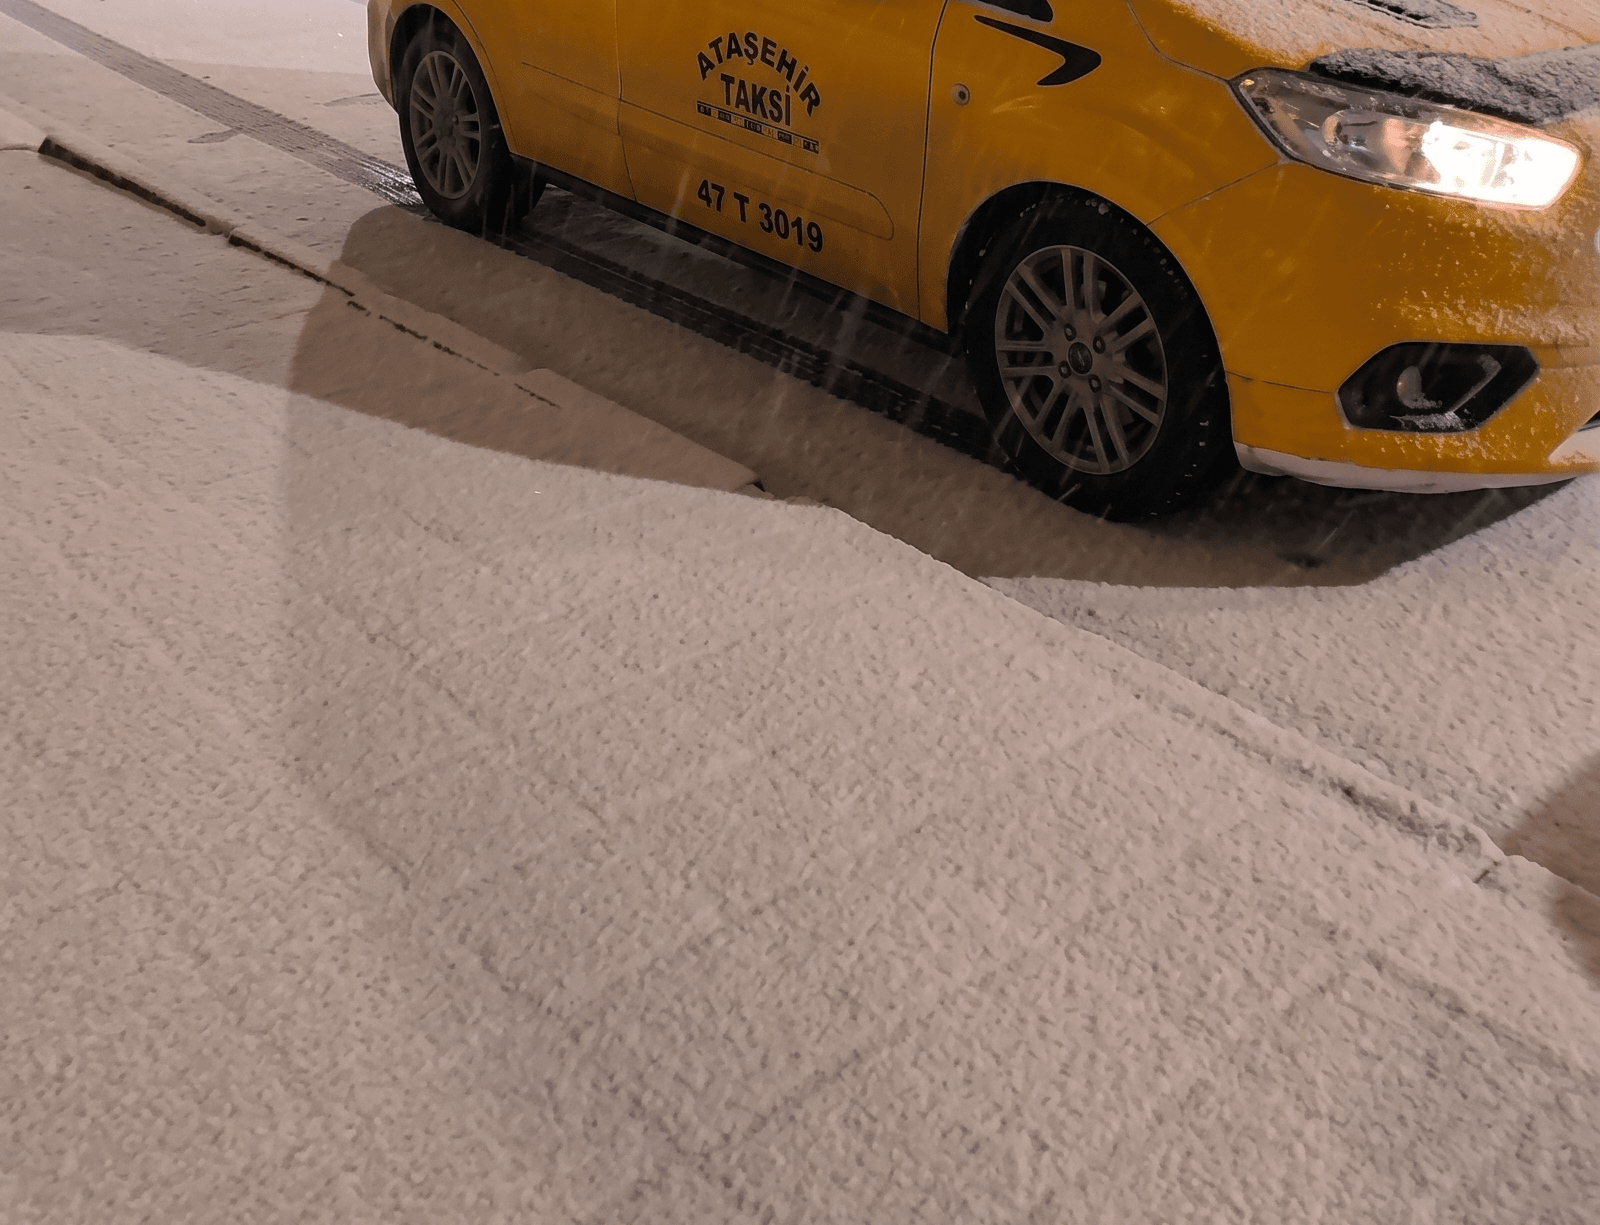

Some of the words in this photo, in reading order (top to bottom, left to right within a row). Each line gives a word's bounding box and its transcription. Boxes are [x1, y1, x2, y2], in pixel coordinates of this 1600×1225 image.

[696, 31, 821, 117] ATAŞEHİR
[720, 72, 791, 127] TAKSİ
[697, 178, 726, 213] 47
[733, 190, 750, 224] T
[758, 201, 824, 254] 3019
